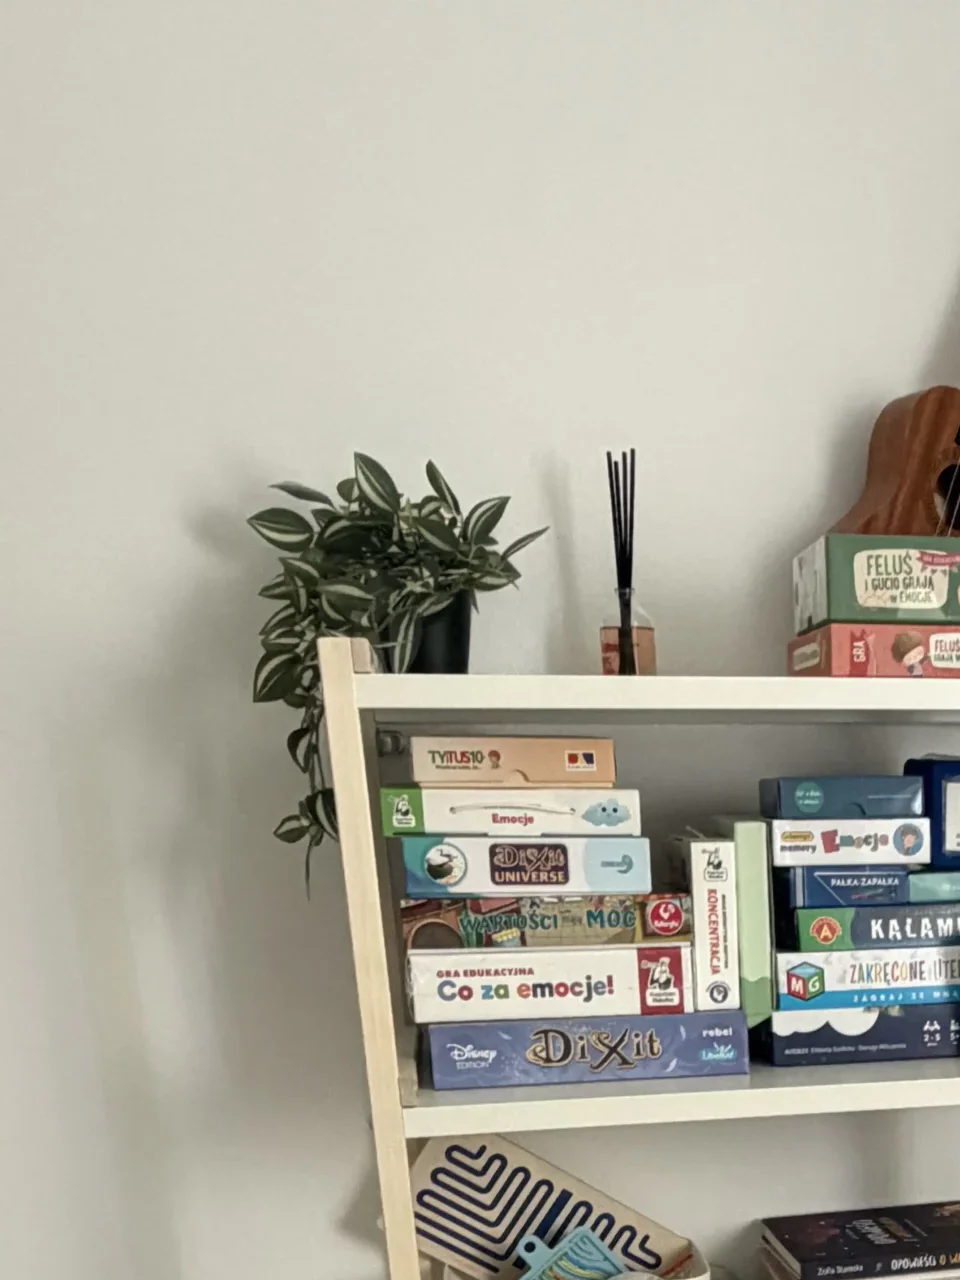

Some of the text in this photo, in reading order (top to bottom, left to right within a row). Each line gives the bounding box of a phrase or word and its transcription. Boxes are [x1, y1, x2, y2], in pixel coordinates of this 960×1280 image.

[866, 550, 913, 576] FELUŚ
[871, 577, 899, 591] GUCIO
[491, 813, 534, 826] Emocje
[820, 829, 890, 854] Emocje
[495, 871, 566, 883] UNIVERSE
[459, 910, 558, 934] WARTOŚCI
[707, 888, 721, 976] KONCENTRACJA
[436, 967, 534, 979] GRA EDUKACYJNA
[849, 959, 927, 986] ZAKRĘCONE
[437, 974, 615, 1003] Co za emocje!
[702, 1027, 733, 1038] rebel
